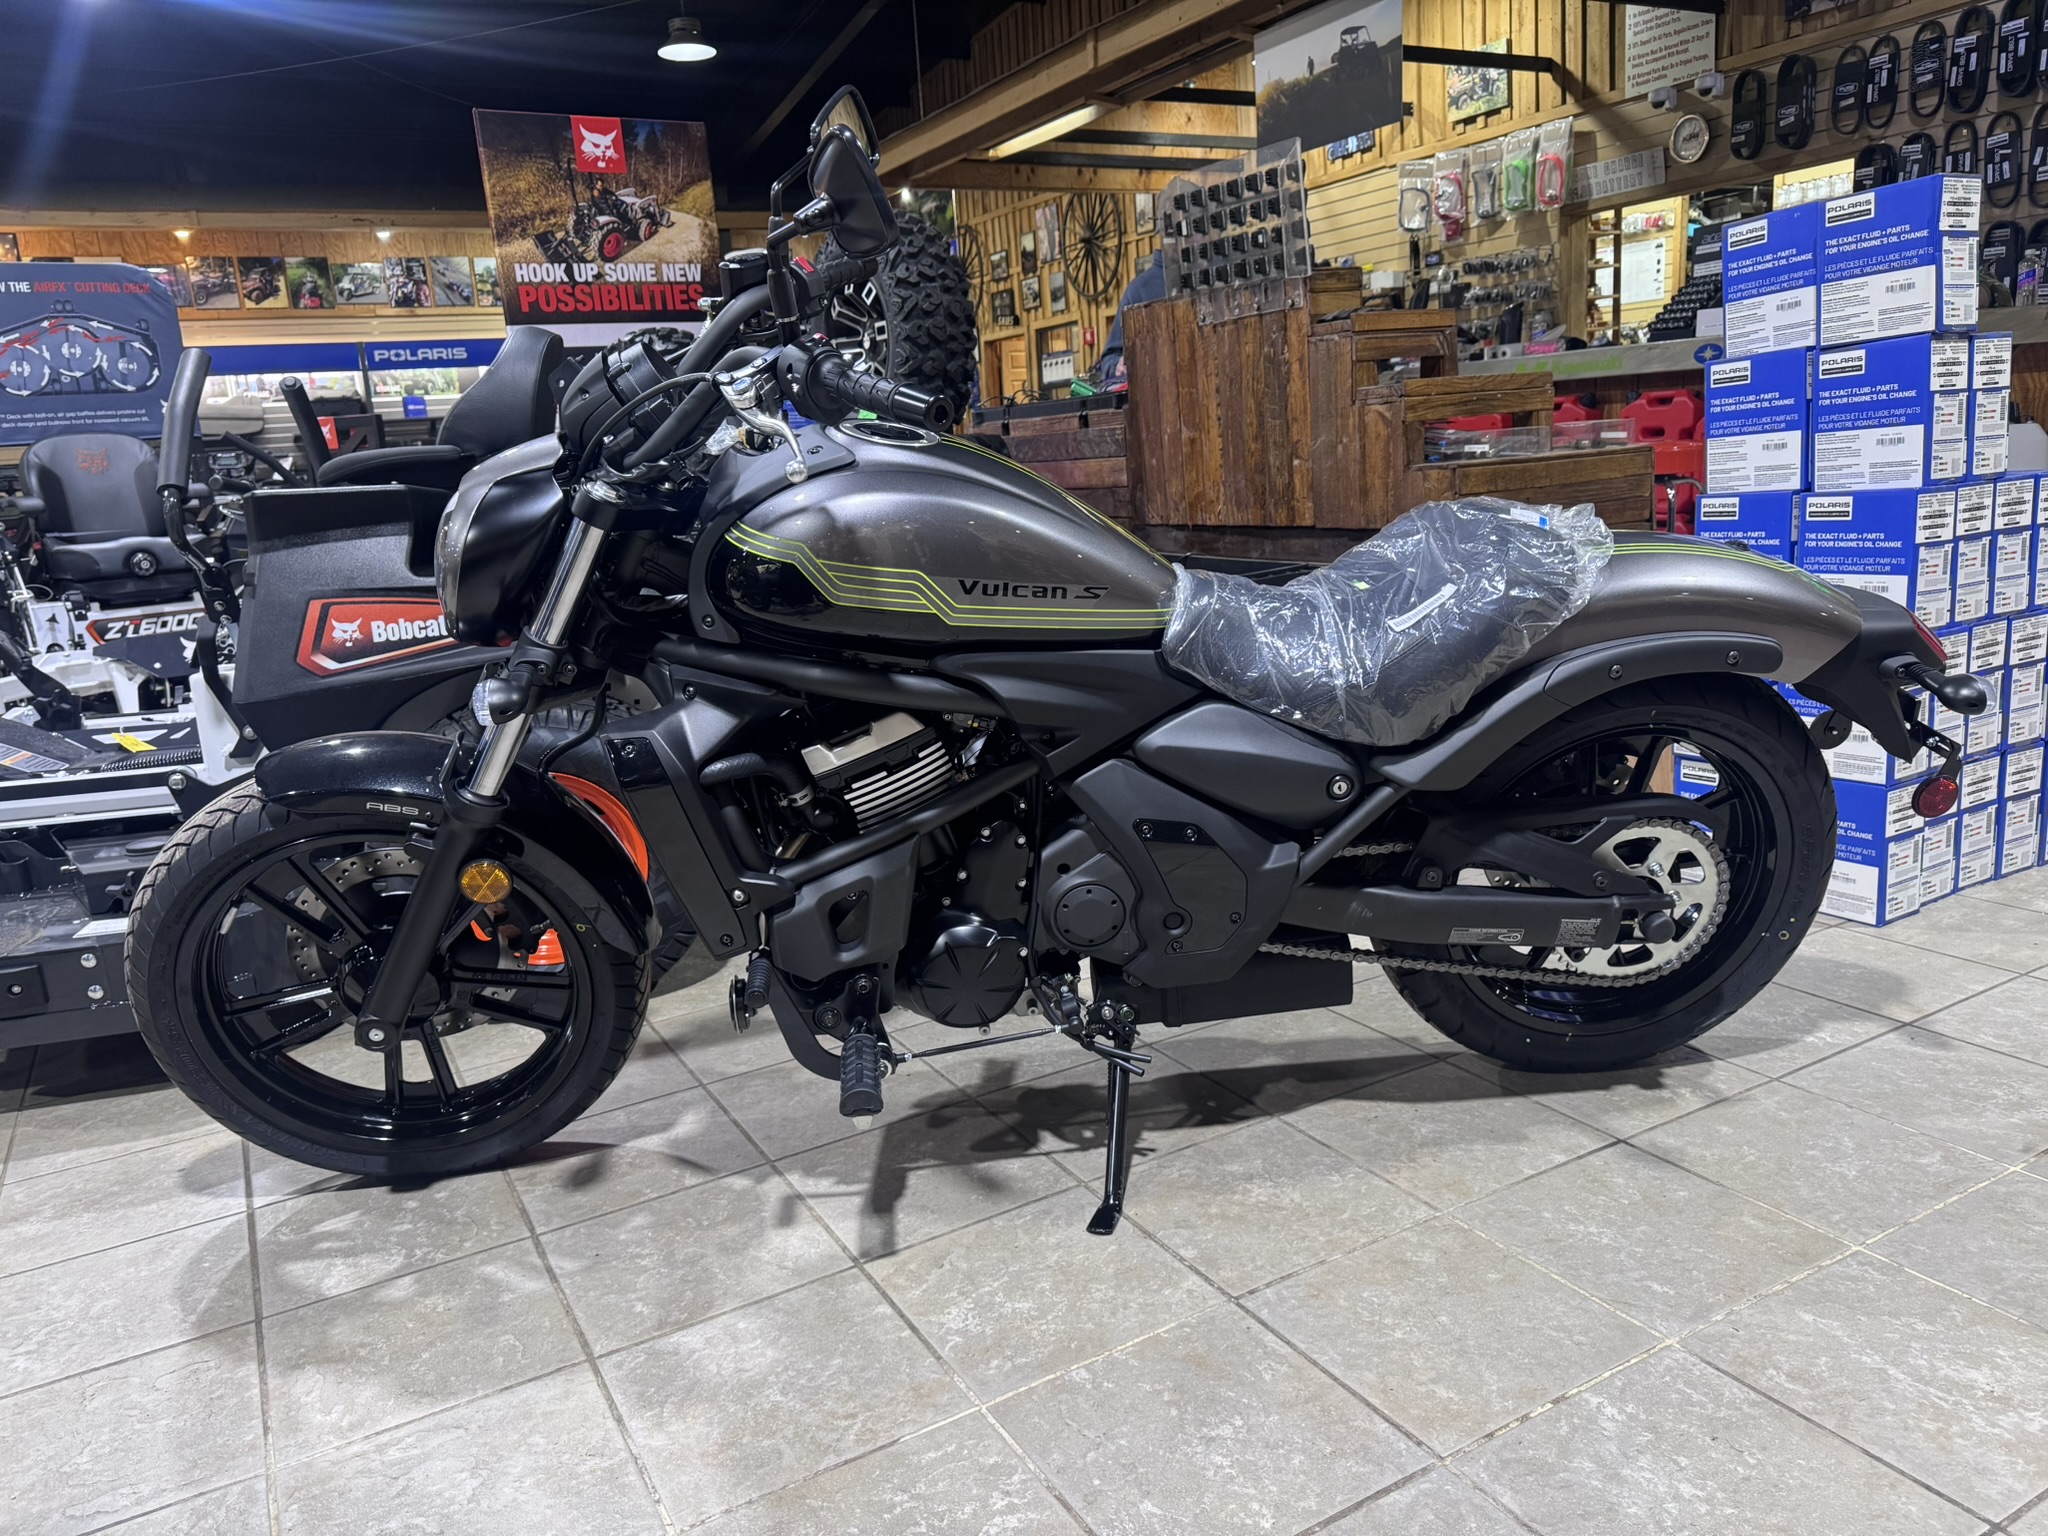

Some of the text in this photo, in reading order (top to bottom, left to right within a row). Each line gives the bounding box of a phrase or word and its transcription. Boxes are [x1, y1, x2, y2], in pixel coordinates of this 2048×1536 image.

[1828, 199, 1872, 214] POLARIS
[1702, 232, 1721, 244] ace
[1730, 225, 1765, 239] POLARIS
[1826, 225, 1910, 246] THE EXACT FLUID PARTS
[1826, 247, 1837, 255] FOR
[1839, 243, 1856, 252] YOUR
[1889, 235, 1899, 243] OIL
[1901, 230, 1929, 241] CHANGE
[1739, 258, 1756, 267] EXACT
[1757, 254, 1773, 263] FLUID
[1778, 248, 1796, 258] PARTS
[1878, 253, 1900, 262] FLUIDE
[1902, 247, 1933, 258] PARFAITS
[1740, 266, 1753, 274] YOUR
[1789, 253, 1813, 264] CHANGE
[1825, 258, 1918, 280] POUR VOTRE VIDANGE MOTEUR
[514, 263, 701, 283] HOOK UP SOME NEW
[8, 282, 31, 292] THE
[74, 282, 121, 294] CUTTING
[123, 283, 150, 294] DECK
[517, 284, 704, 313] POSSIBILITIES
[374, 347, 467, 363] POLARIS
[1822, 356, 1863, 366] POLARIS
[1713, 367, 1748, 376] POLARIS
[1890, 390, 1917, 399] CHANGE
[1772, 398, 1795, 406] CHANGE
[1891, 407, 1920, 415] PARFAITS
[1773, 414, 1798, 422] PARFAITS
[958, 579, 1110, 600] Vulcan S
[371, 614, 448, 643] Bobcat
[1683, 765, 1717, 774] POLARIS
[366, 802, 419, 815] ABS
[1847, 830, 1873, 840] CHANGE
[1838, 851, 1862, 861] MOTEUR
[1848, 845, 1876, 856] PARFAITS
